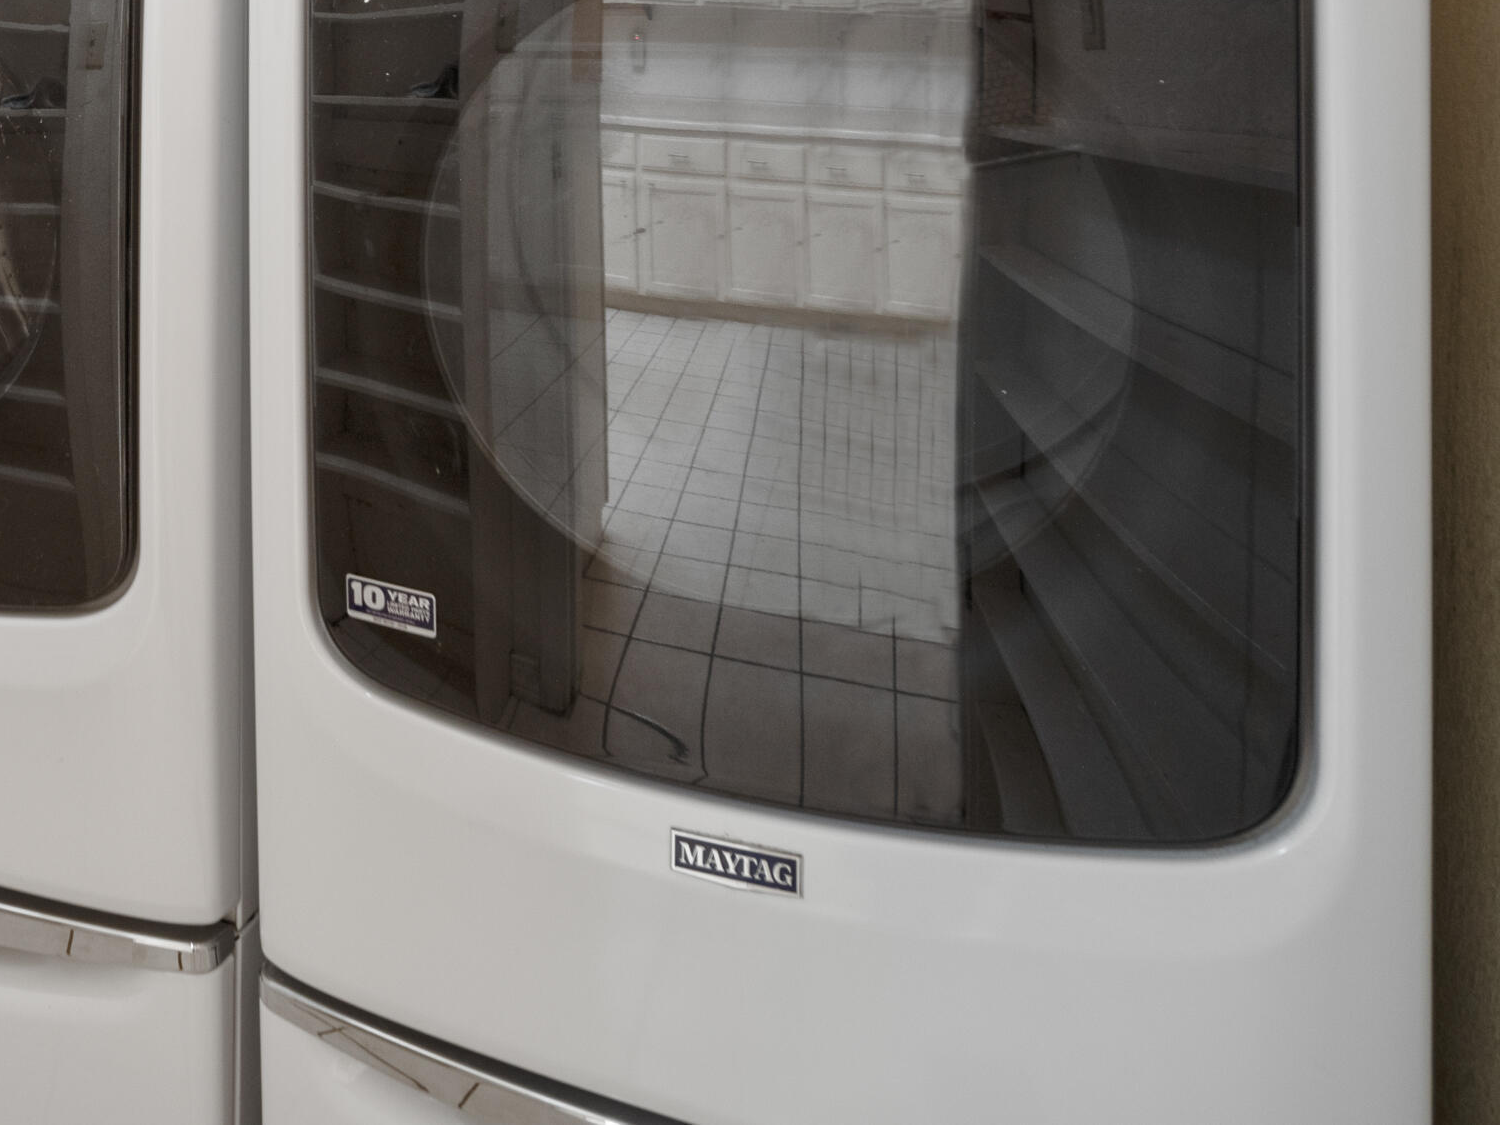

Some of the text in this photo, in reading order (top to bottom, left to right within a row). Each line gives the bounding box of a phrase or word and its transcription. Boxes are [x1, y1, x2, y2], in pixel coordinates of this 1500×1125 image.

[350, 580, 430, 611] 10 YEAR
[679, 841, 793, 887] MAYTAG
